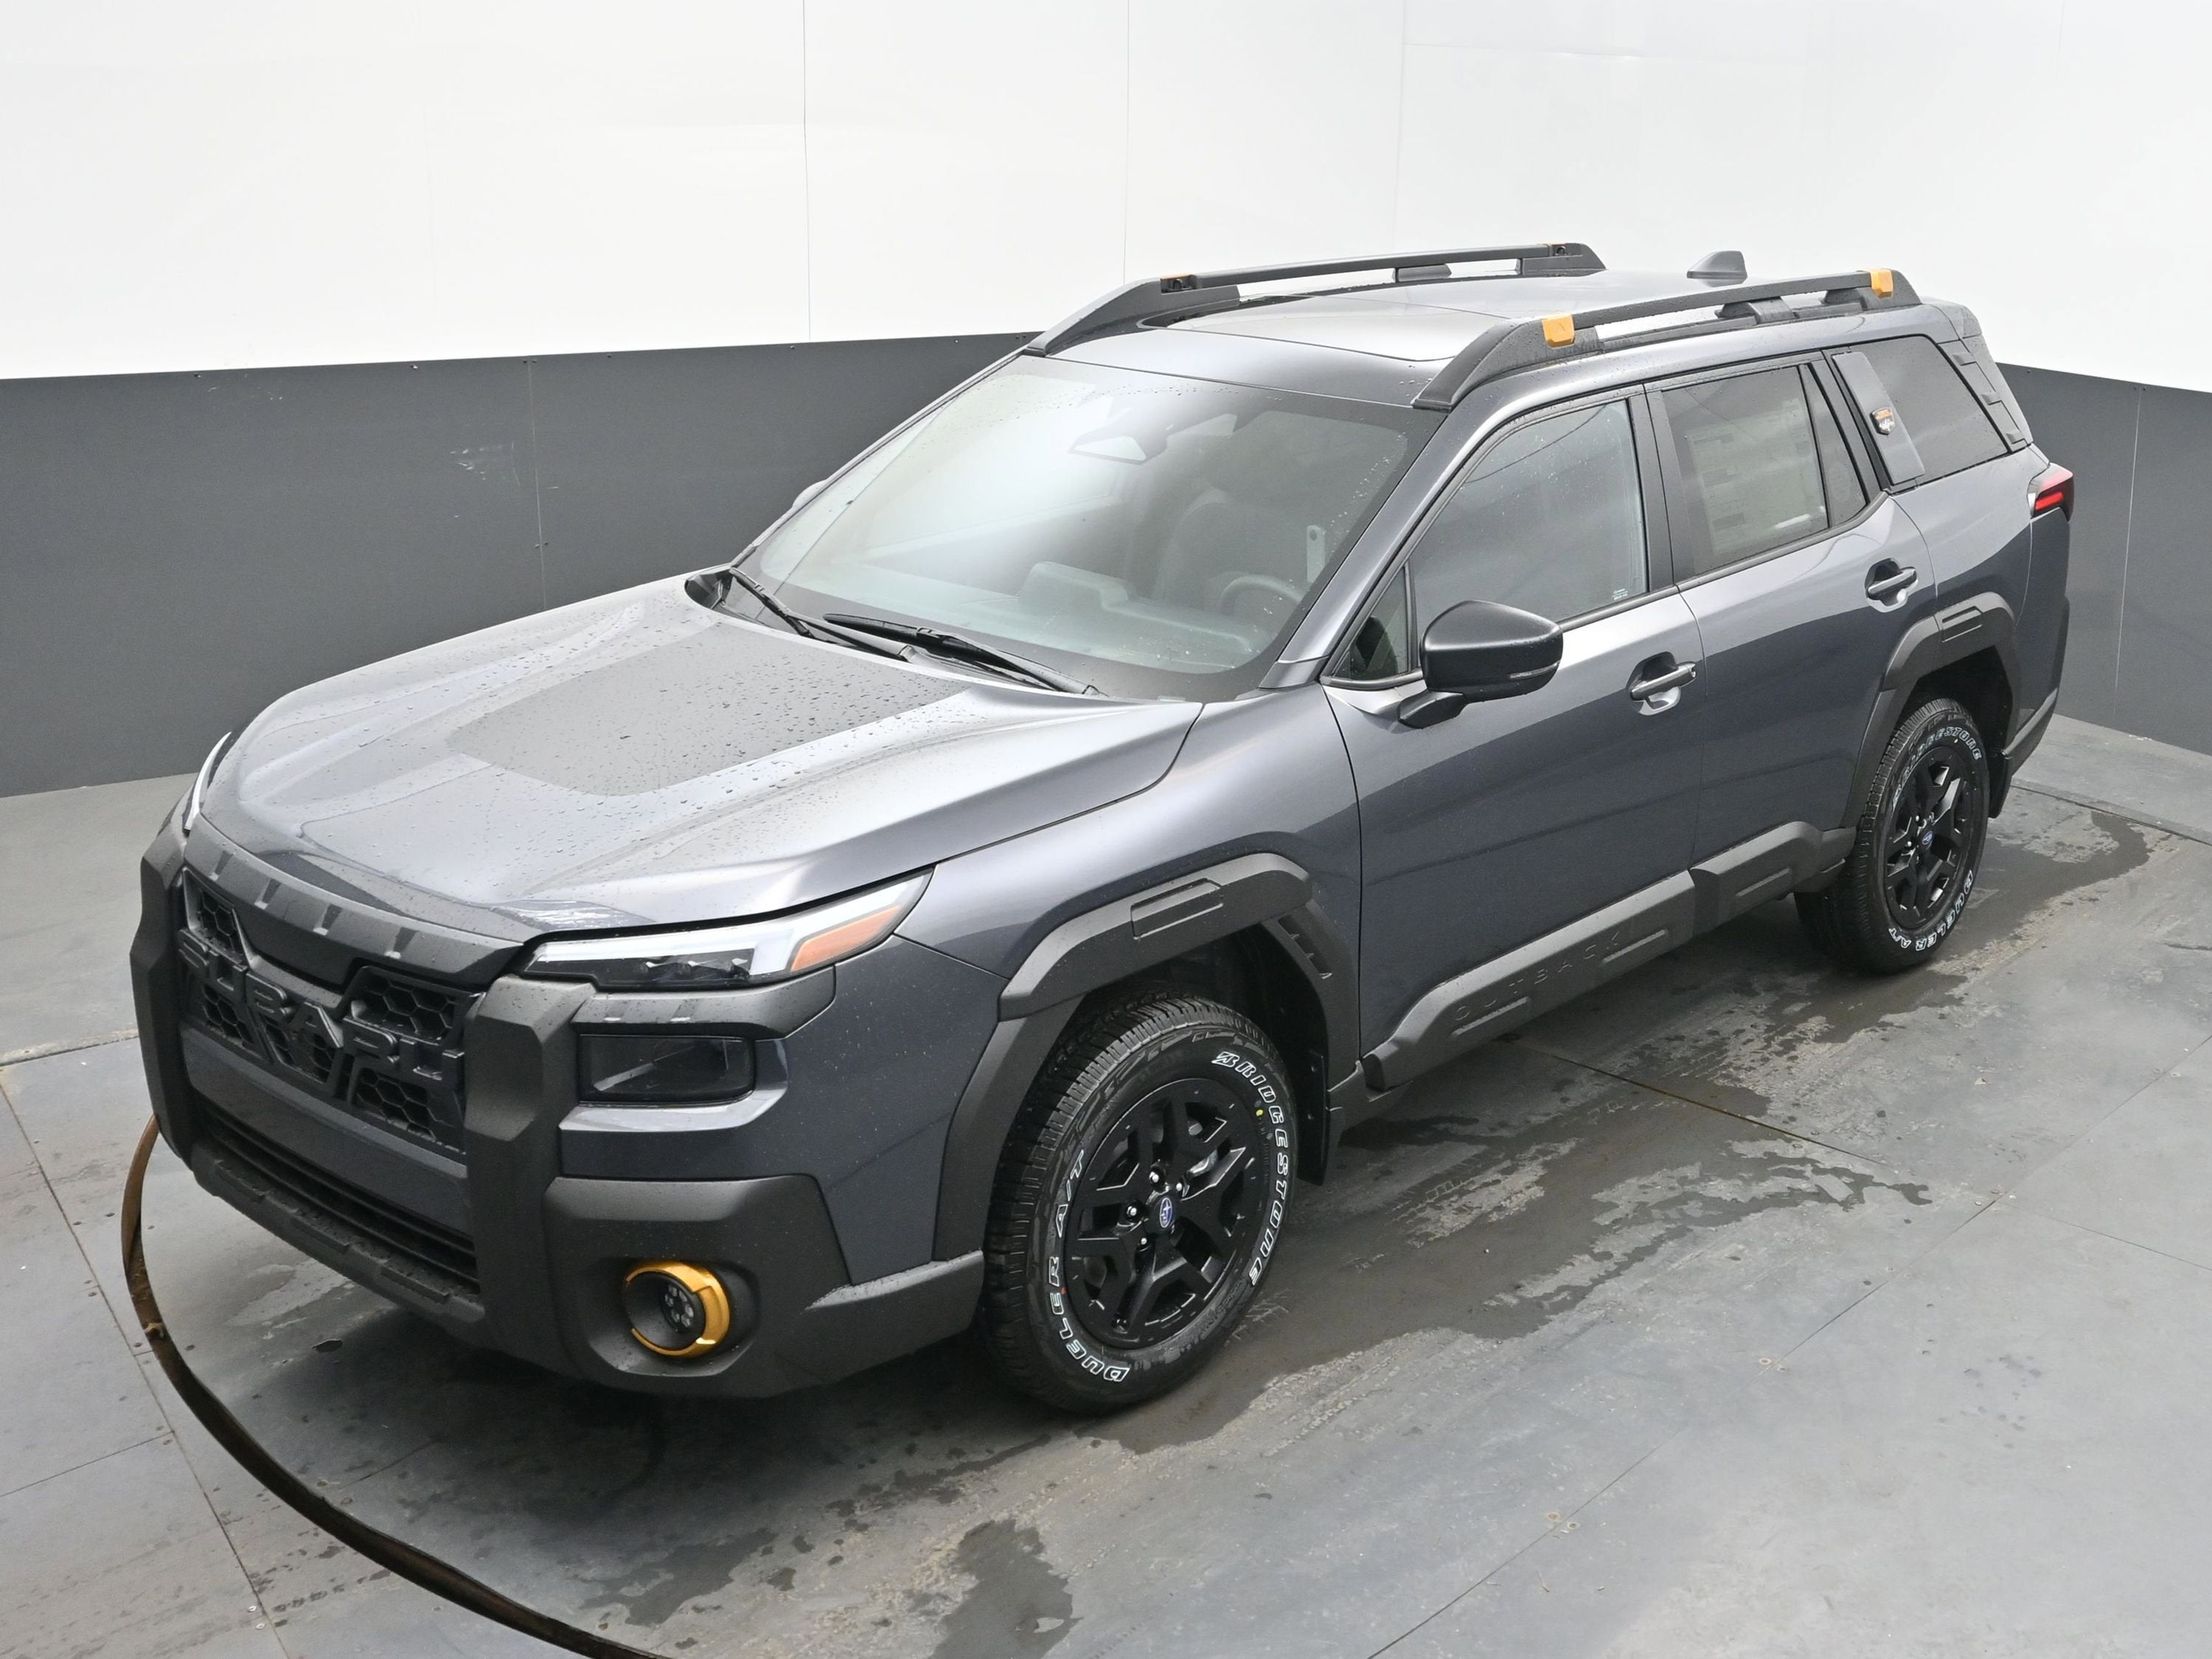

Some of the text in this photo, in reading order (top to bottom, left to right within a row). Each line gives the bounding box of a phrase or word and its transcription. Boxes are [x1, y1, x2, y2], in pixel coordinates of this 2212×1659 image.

[1888, 869, 1974, 951] DUELER A/T
[178, 928, 465, 1090] SUBARU
[1048, 1149, 1130, 1382] DUELER A/T
[1211, 1051, 1289, 1285] BRIDGESTONE
